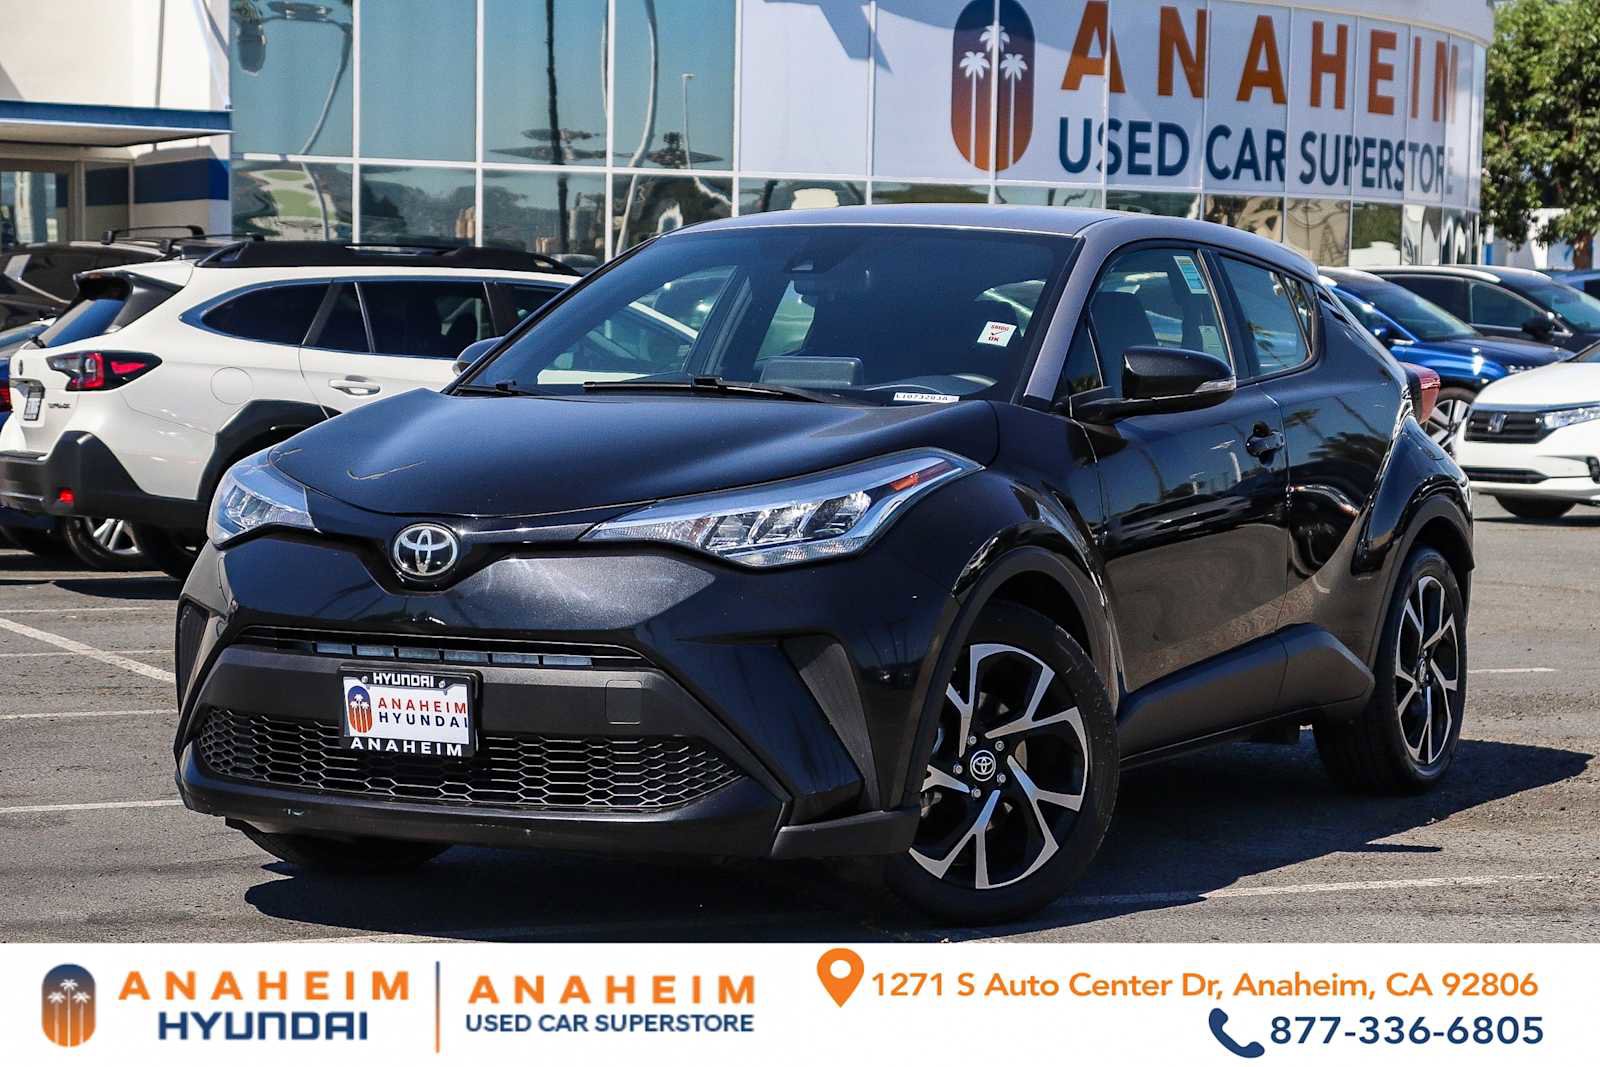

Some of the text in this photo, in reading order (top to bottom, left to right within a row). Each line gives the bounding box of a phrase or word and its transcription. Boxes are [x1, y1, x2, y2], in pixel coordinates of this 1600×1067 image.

[1060, 0, 1459, 124] ANAHEIM
[1059, 117, 1454, 196] USED CAR SUPERSTORE
[373, 672, 434, 688] HYUNDAI
[378, 697, 466, 714] ANAHEIM
[379, 711, 468, 729] HYUNDAI
[350, 737, 463, 757] ANAHEIM
